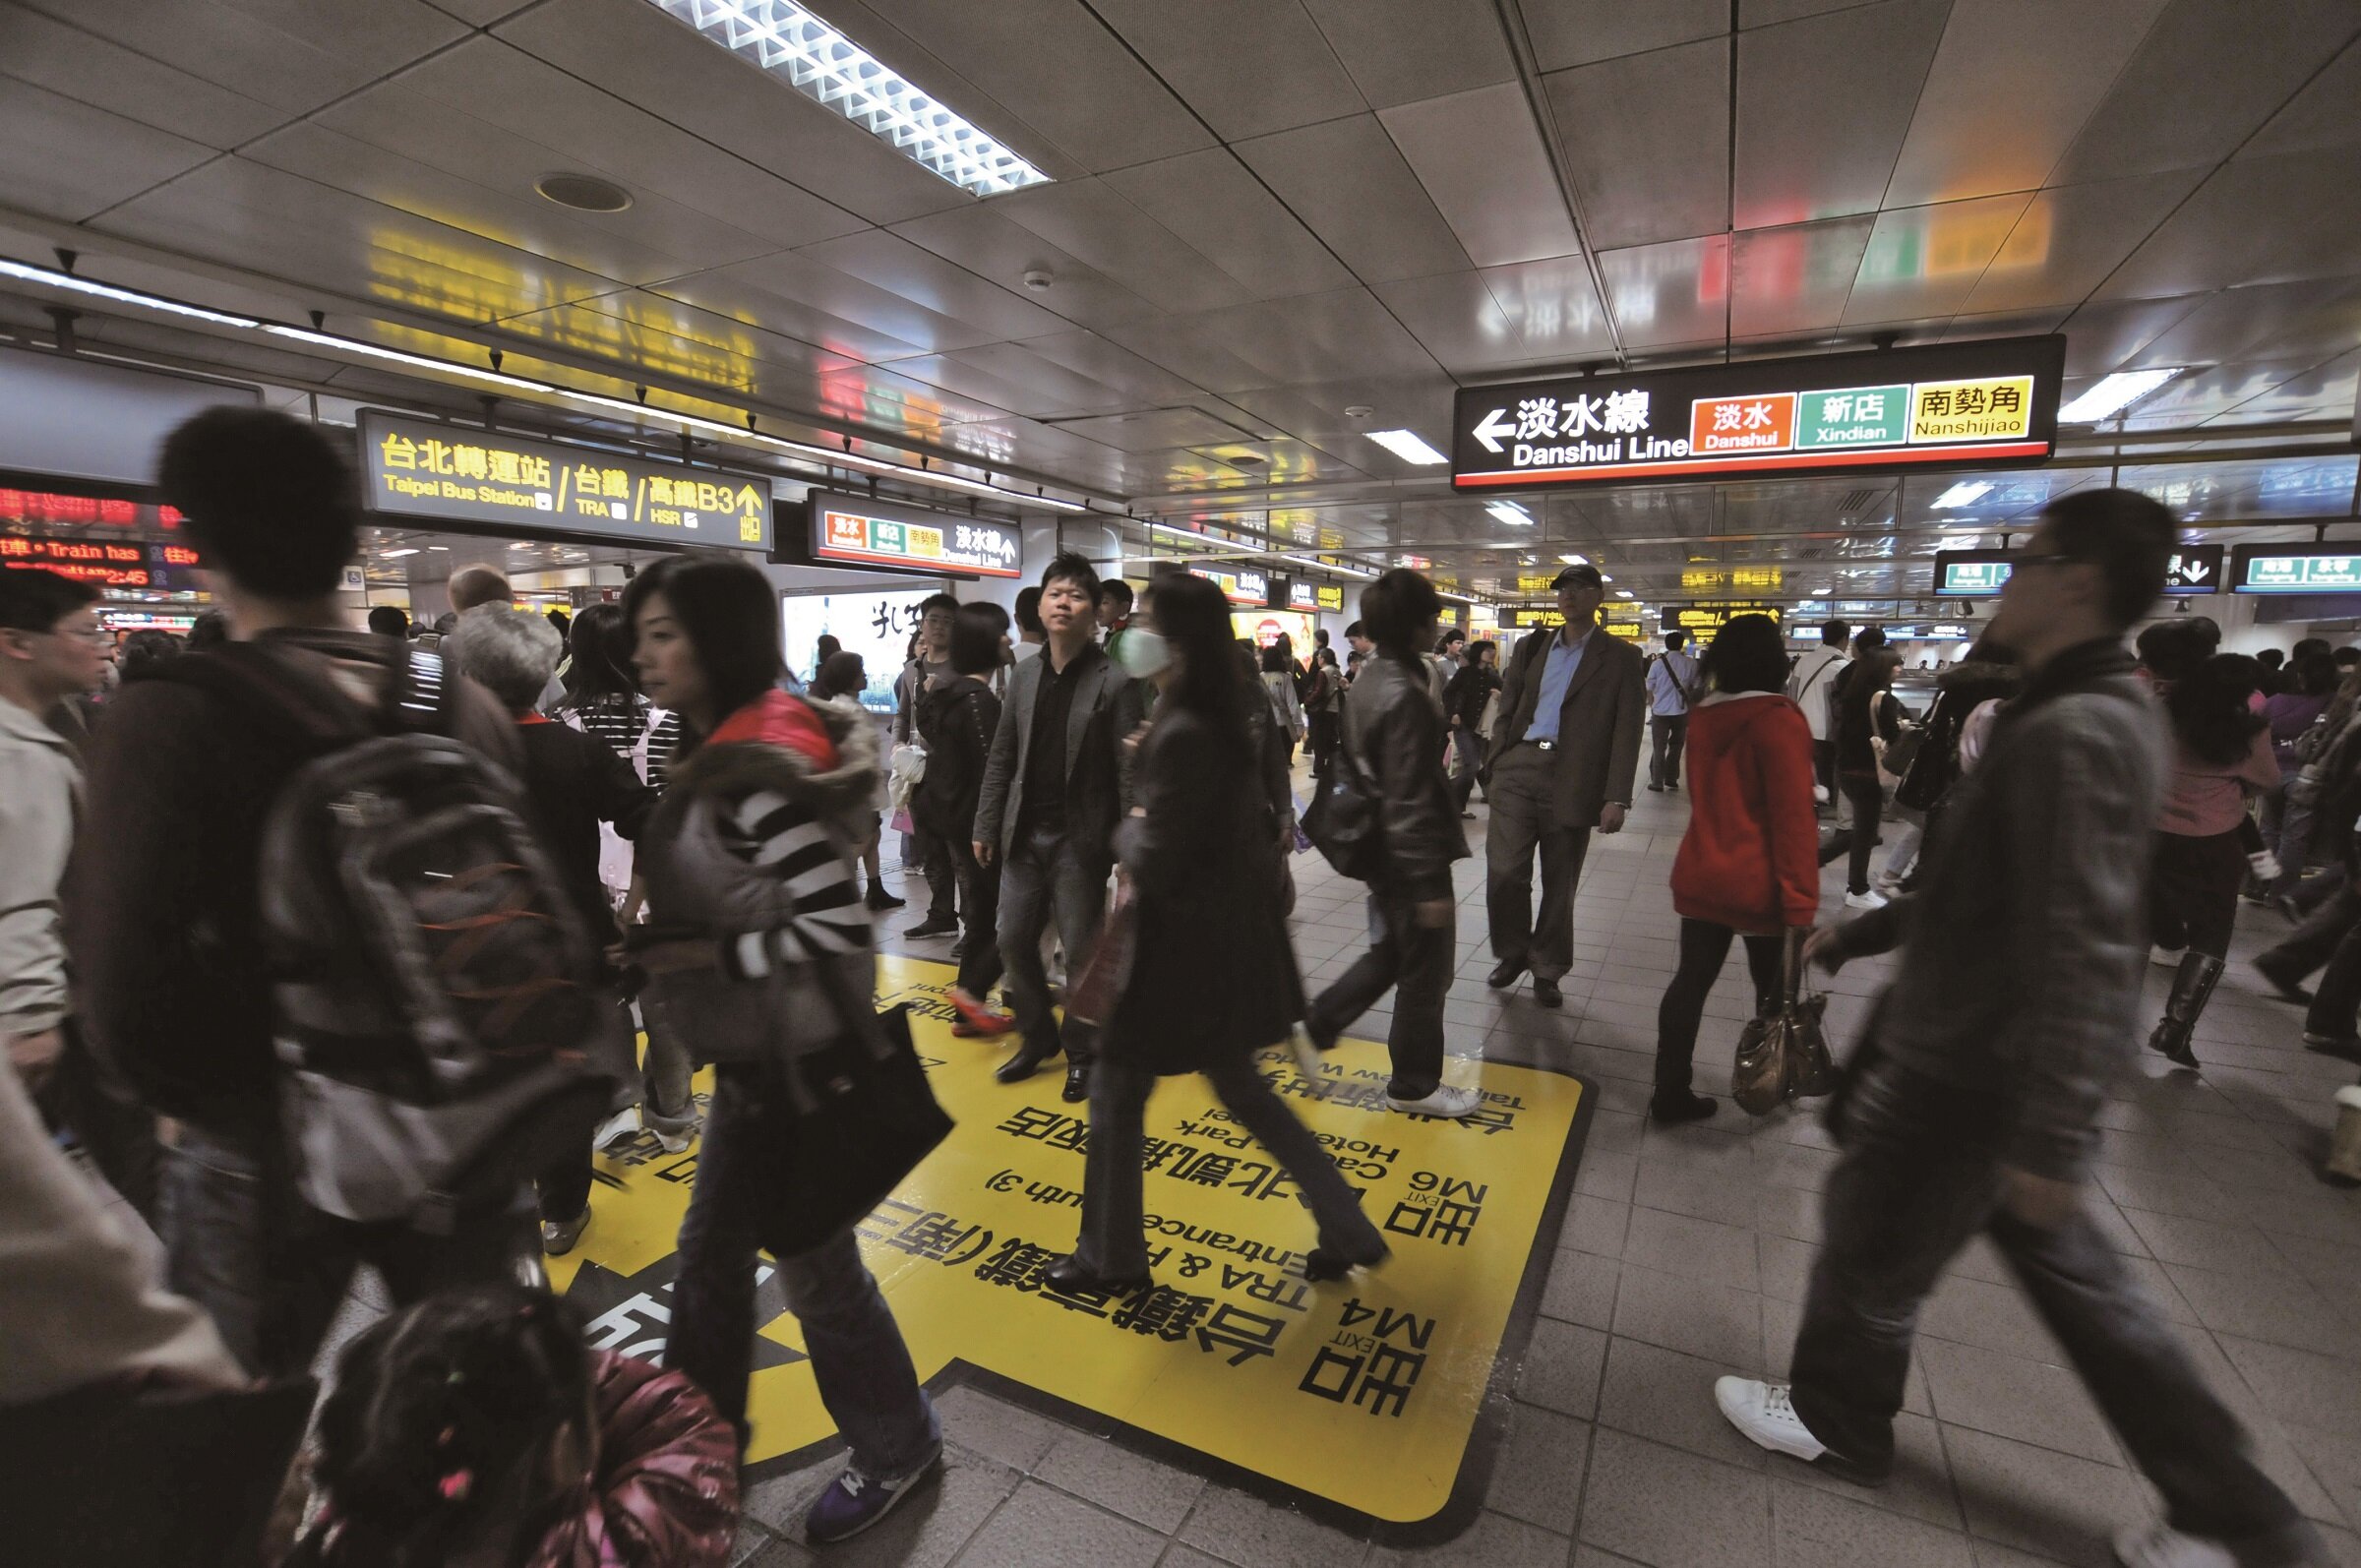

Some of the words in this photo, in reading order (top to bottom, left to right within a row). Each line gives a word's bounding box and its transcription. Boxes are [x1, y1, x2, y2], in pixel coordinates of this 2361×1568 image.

[1515, 390, 1650, 441] 淡水線
[1822, 393, 1886, 424] 新店
[1919, 383, 2023, 418] 南勢角
[1712, 401, 1773, 432] 淡水
[1815, 420, 1887, 444] Xindian
[1913, 411, 2023, 439] Nanshijiao
[1514, 438, 1621, 467] Danshui
[1628, 435, 1689, 460] Line
[1705, 429, 1779, 451] Danshui
[381, 433, 551, 489] 台北轉運站
[382, 473, 440, 498] Taipei
[442, 481, 476, 500] Bus
[478, 485, 535, 509] Station
[575, 498, 609, 517] TRA
[649, 508, 682, 526] HSR
[47, 542, 103, 560] Train
[105, 545, 140, 562] has
[910, 528, 940, 547] 南勢角
[955, 524, 1001, 553] 淡水線
[105, 569, 149, 585] 2:45
[1174, 1119, 1256, 1150] Park
[984, 1168, 1023, 1195] 3)
[1408, 1171, 1489, 1204] M6
[1403, 1189, 1441, 1207] EXIT
[1383, 1199, 1482, 1246] 出口
[1142, 1215, 1306, 1279] Entrance
[1178, 1252, 1213, 1278] &
[1220, 1263, 1309, 1313] TRA
[1338, 1298, 1436, 1350] M4
[1328, 1330, 1377, 1355] EXIT
[1298, 1343, 1428, 1419] 出口
